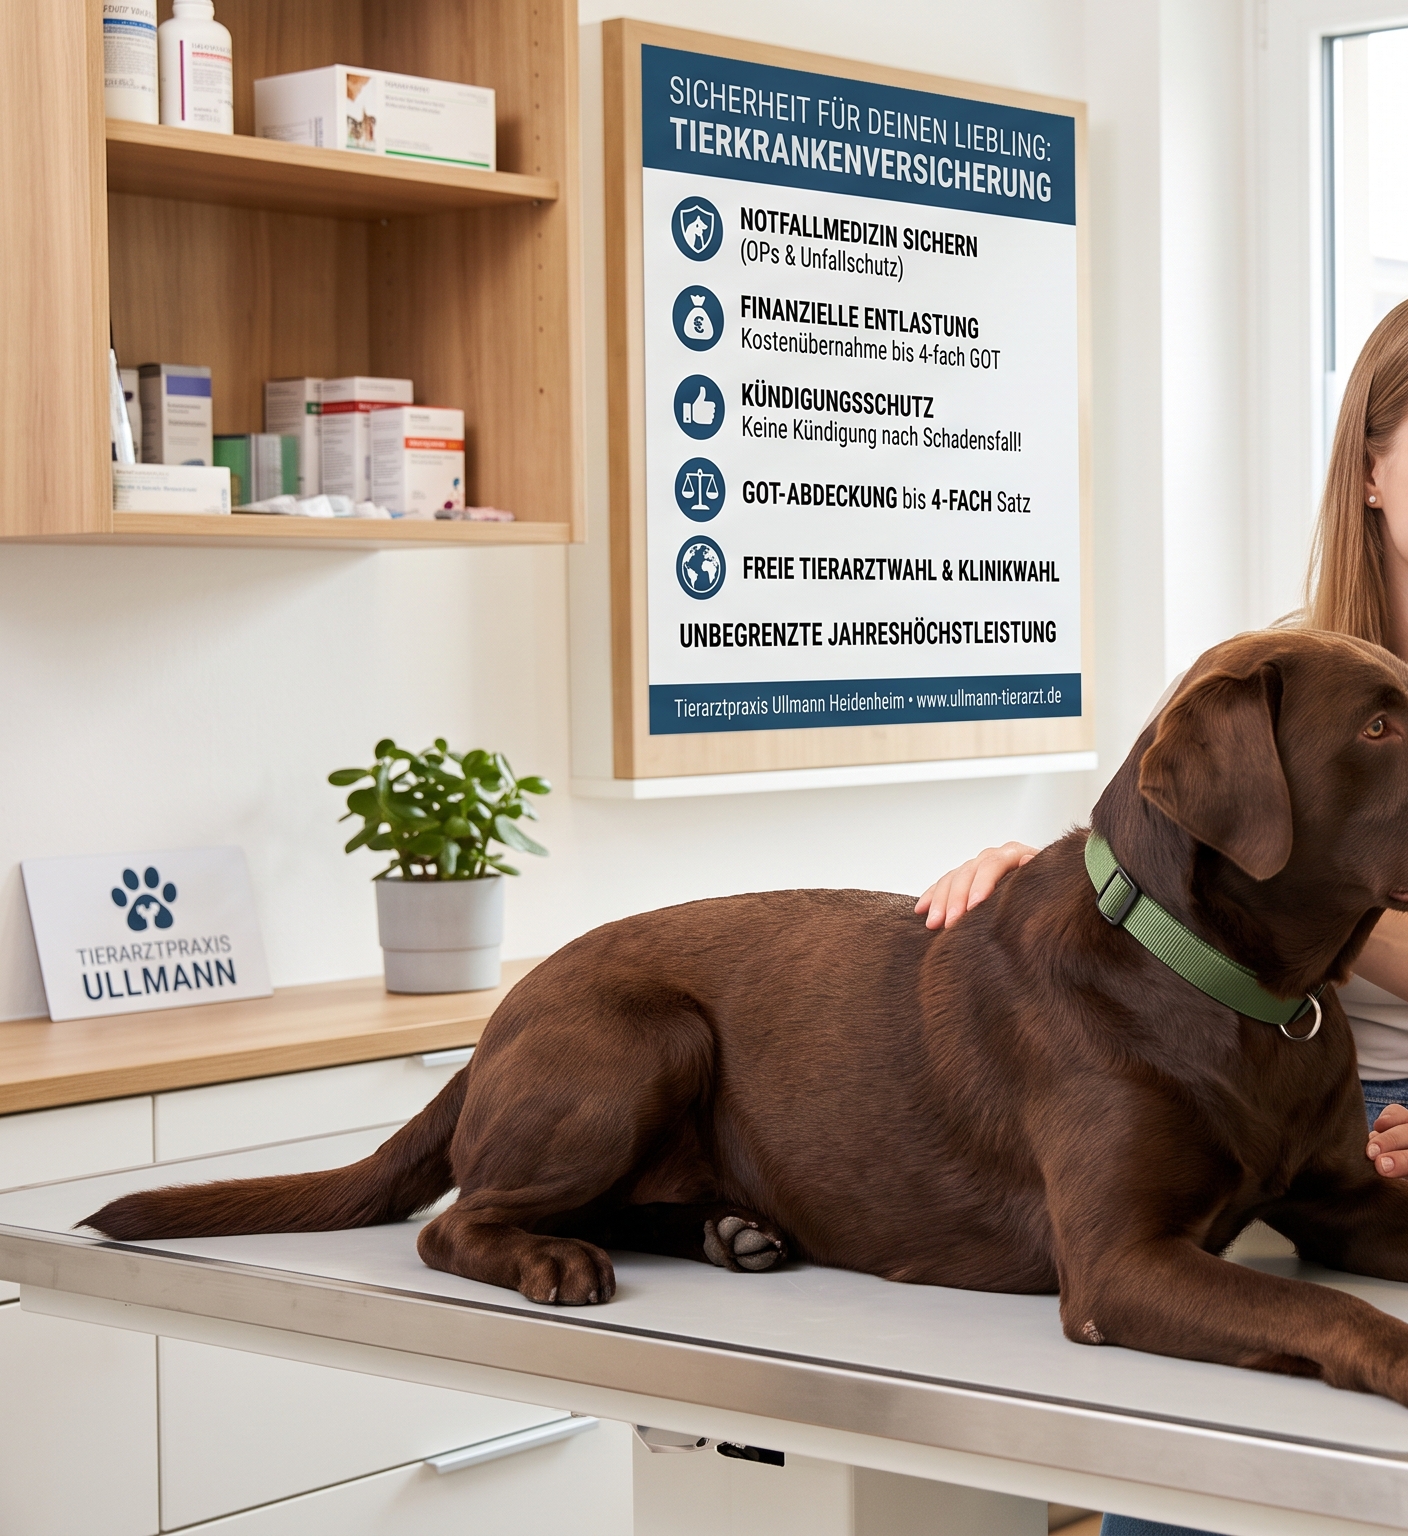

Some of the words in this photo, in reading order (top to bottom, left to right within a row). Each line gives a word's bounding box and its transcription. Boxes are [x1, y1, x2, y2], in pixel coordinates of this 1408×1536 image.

[669, 75, 811, 124] SICHERHEIT
[818, 97, 861, 133] FÜR
[868, 107, 947, 146] DEINEN
[955, 121, 1051, 162] LIEBLING:
[669, 116, 1052, 203] TIERKRANKENVERSICHERUNG
[740, 206, 898, 249] NOTFALLMEDIZIN
[902, 227, 978, 258] SICHERN
[740, 237, 780, 267] (OPs
[784, 244, 796, 266] &
[800, 245, 904, 283] Unfallschutz)
[740, 294, 859, 329] FINANZIELLE
[864, 306, 979, 340] ENTLASTUNG
[741, 327, 888, 361] Kostenübernahme
[892, 339, 914, 363] bis
[918, 343, 965, 367] 4-fach
[970, 347, 1001, 370] GOT
[741, 379, 934, 419] KÜNDIGUNGSSCHUTZ
[742, 415, 788, 440] Keine
[793, 418, 877, 450] Kündigung
[882, 425, 918, 447] nach
[923, 426, 1022, 453] Schadensfall!
[742, 480, 898, 509] GOT-ABDECKUNG
[902, 486, 926, 510] bis
[931, 488, 992, 512] 4-FACH
[997, 490, 1031, 514] Satz
[743, 556, 795, 580] FREIE
[798, 556, 938, 581] TIERARZTWAHL
[941, 559, 954, 582] &
[958, 559, 1060, 583] KLINIKWAHL
[679, 622, 823, 649] UNBEGRENZTE
[827, 616, 1057, 647] JAHRESHÖCHSTLEISTUNG
[674, 698, 769, 721] Tierarztpraxis
[772, 694, 826, 714] Ullmann
[829, 691, 905, 712] Heidenheim
[916, 685, 1062, 709] www.ullmann-tierarzt.de
[76, 934, 232, 966] TIERARZTPRAXIS
[82, 958, 237, 1001] ULLMANN
